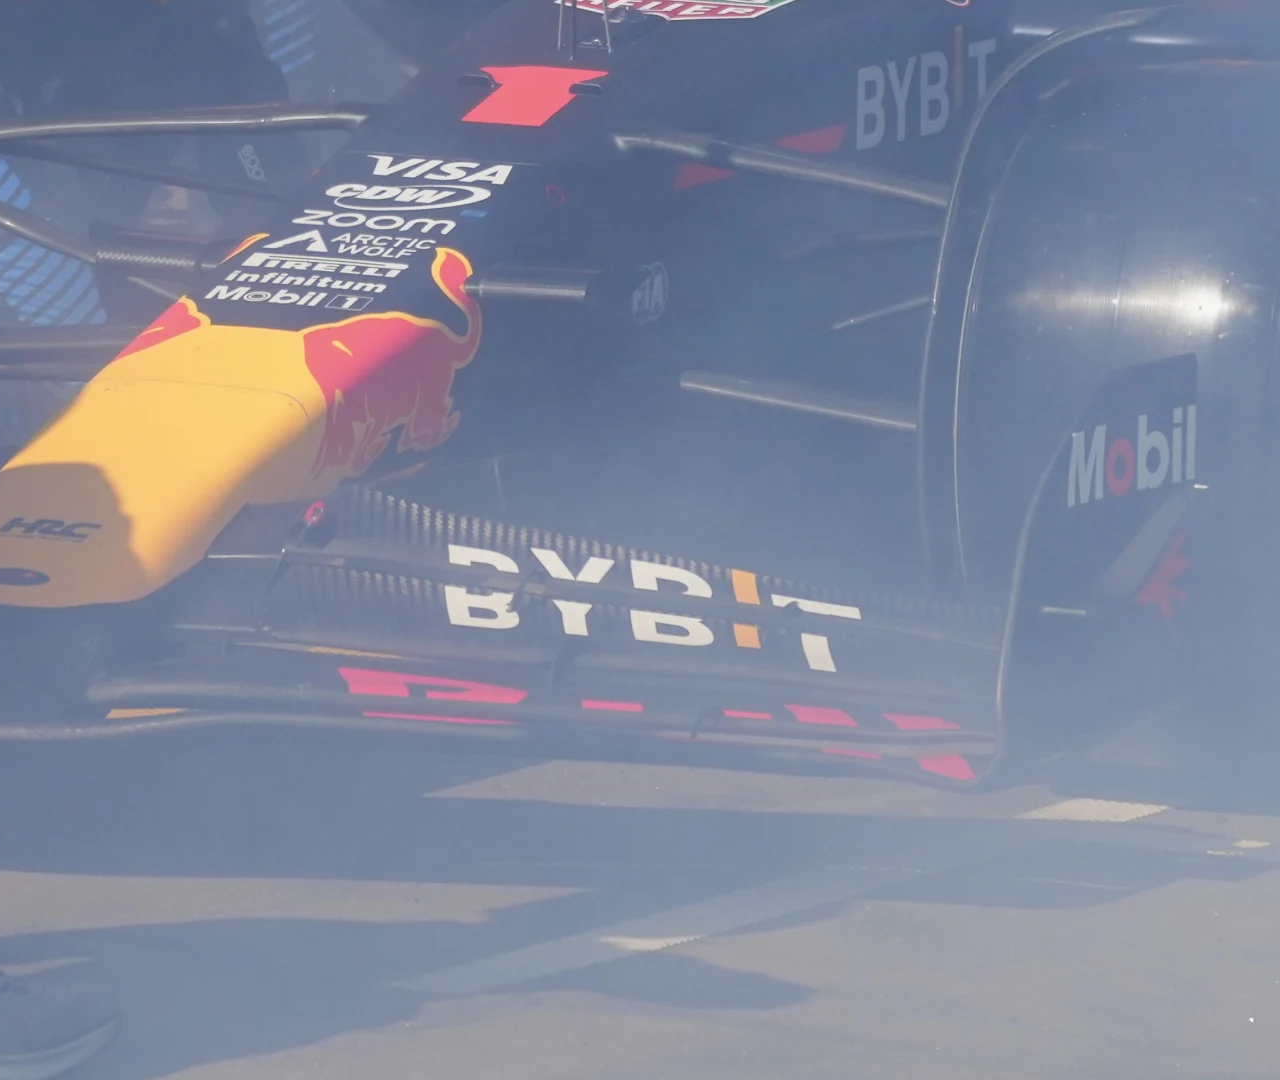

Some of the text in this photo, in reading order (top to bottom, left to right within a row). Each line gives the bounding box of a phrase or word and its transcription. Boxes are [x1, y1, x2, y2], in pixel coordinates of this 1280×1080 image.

[856, 25, 997, 151] BYBIT
[366, 154, 514, 185] VISA
[331, 232, 437, 250] ARCTIC
[336, 243, 418, 259] WOLF
[241, 252, 410, 279] PIRELLI
[225, 270, 388, 294] infinitum
[204, 285, 328, 308] Mobil
[1066, 404, 1197, 508] Mobil
[443, 544, 862, 673] BYBIT
